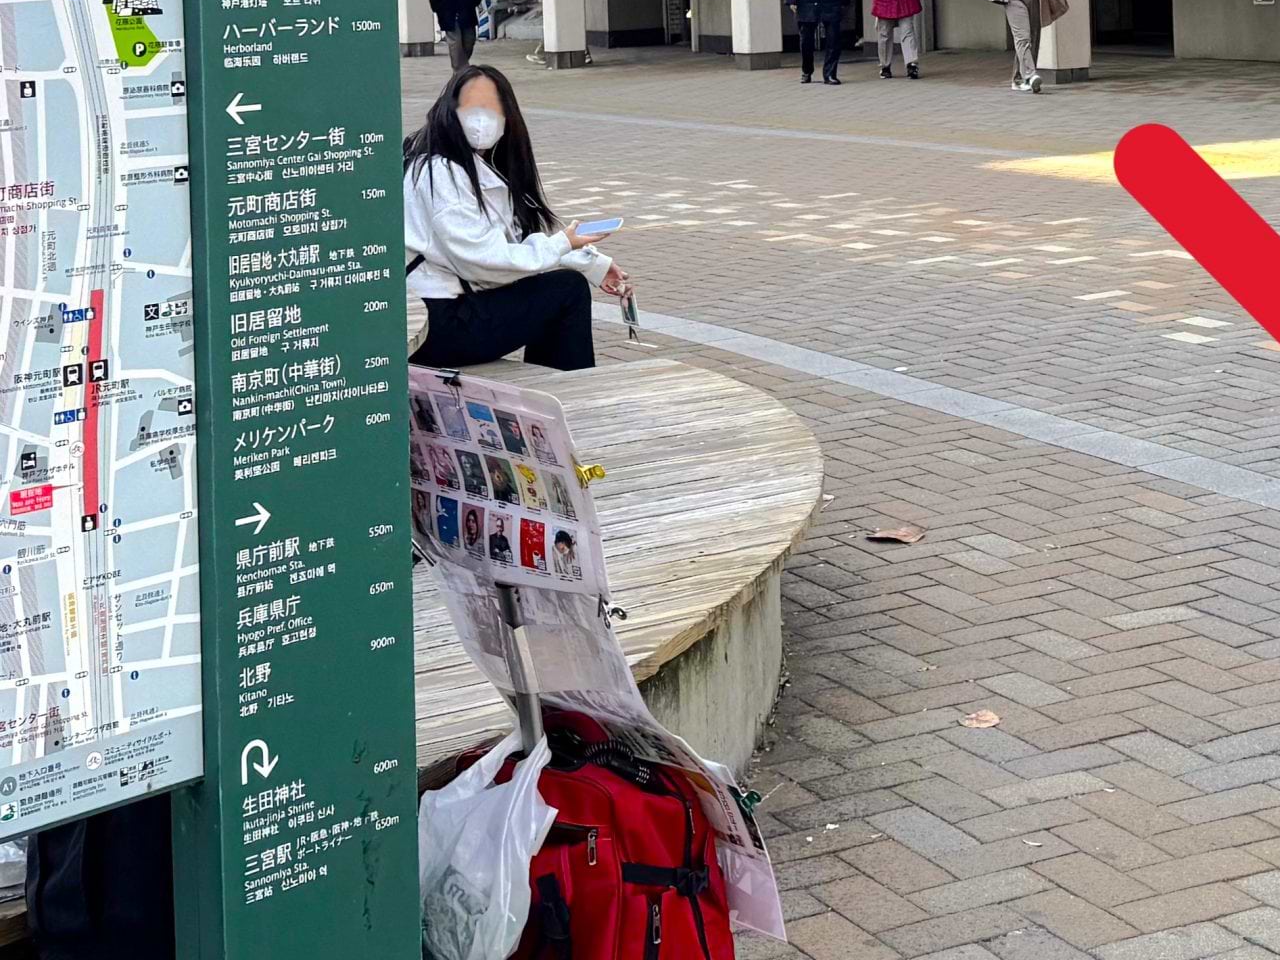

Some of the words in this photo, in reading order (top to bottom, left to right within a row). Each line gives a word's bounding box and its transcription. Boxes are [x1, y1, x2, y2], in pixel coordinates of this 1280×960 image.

[223, 17, 340, 40] ハーバーランド
[351, 21, 381, 32] 1500m
[226, 126, 346, 156] 三宮センター街
[359, 133, 384, 144] 100m
[227, 157, 275, 171] Sannomiya
[277, 153, 305, 165] Center
[307, 152, 321, 163] Gai
[323, 147, 362, 160] Shopping
[363, 146, 374, 156] St.
[26, 199, 66, 210] Shopping
[227, 188, 317, 217] 元町商店街
[361, 189, 386, 200] 150m
[228, 214, 278, 230] Motomachi
[279, 210, 319, 224] Shopping
[321, 208, 332, 218] St.
[328, 248, 355, 261] 地下鉄
[362, 244, 387, 257] 200m
[347, 261, 363, 271] Sta.
[230, 305, 302, 335] 旧居留地
[363, 300, 388, 313] 200m
[230, 336, 246, 348] Old
[248, 332, 281, 346] Foreign
[283, 323, 330, 340] Settlement
[364, 356, 390, 369] 250m
[14, 367, 61, 384] 阪神元町駅
[91, 379, 130, 395] JR元町駅
[321, 377, 347, 390] Town)
[233, 414, 335, 452] メリケンパーク
[366, 412, 391, 426] 600m
[233, 451, 269, 466] Meriken
[271, 446, 291, 458] Park
[236, 536, 301, 571] 県庁前駅
[308, 538, 335, 552] 地下鉄
[368, 524, 394, 538] 550m
[236, 564, 287, 584] Kenchomae
[289, 560, 306, 571] Sta.
[236, 595, 301, 630] 兵庫県庁
[369, 581, 394, 595] 650m
[237, 629, 265, 644] Hyogo
[267, 621, 286, 635] Pref.
[287, 616, 313, 629] Office
[239, 662, 272, 689] 北野
[370, 636, 395, 651] 900m
[238, 689, 268, 704] Kitano
[267, 693, 295, 709] 기타노
[239, 704, 258, 718] 北野
[242, 778, 306, 818] 生田神社
[373, 758, 398, 774] 600m
[243, 810, 286, 831] Ikuta-jinja
[287, 800, 316, 817] Shrine
[243, 823, 280, 845] 生田神社
[244, 842, 293, 876] 三宮駅
[375, 816, 400, 831] 650m
[297, 835, 353, 859] ポートライナー
[244, 866, 292, 892] Sannomiya
[294, 862, 310, 874] Sta.
